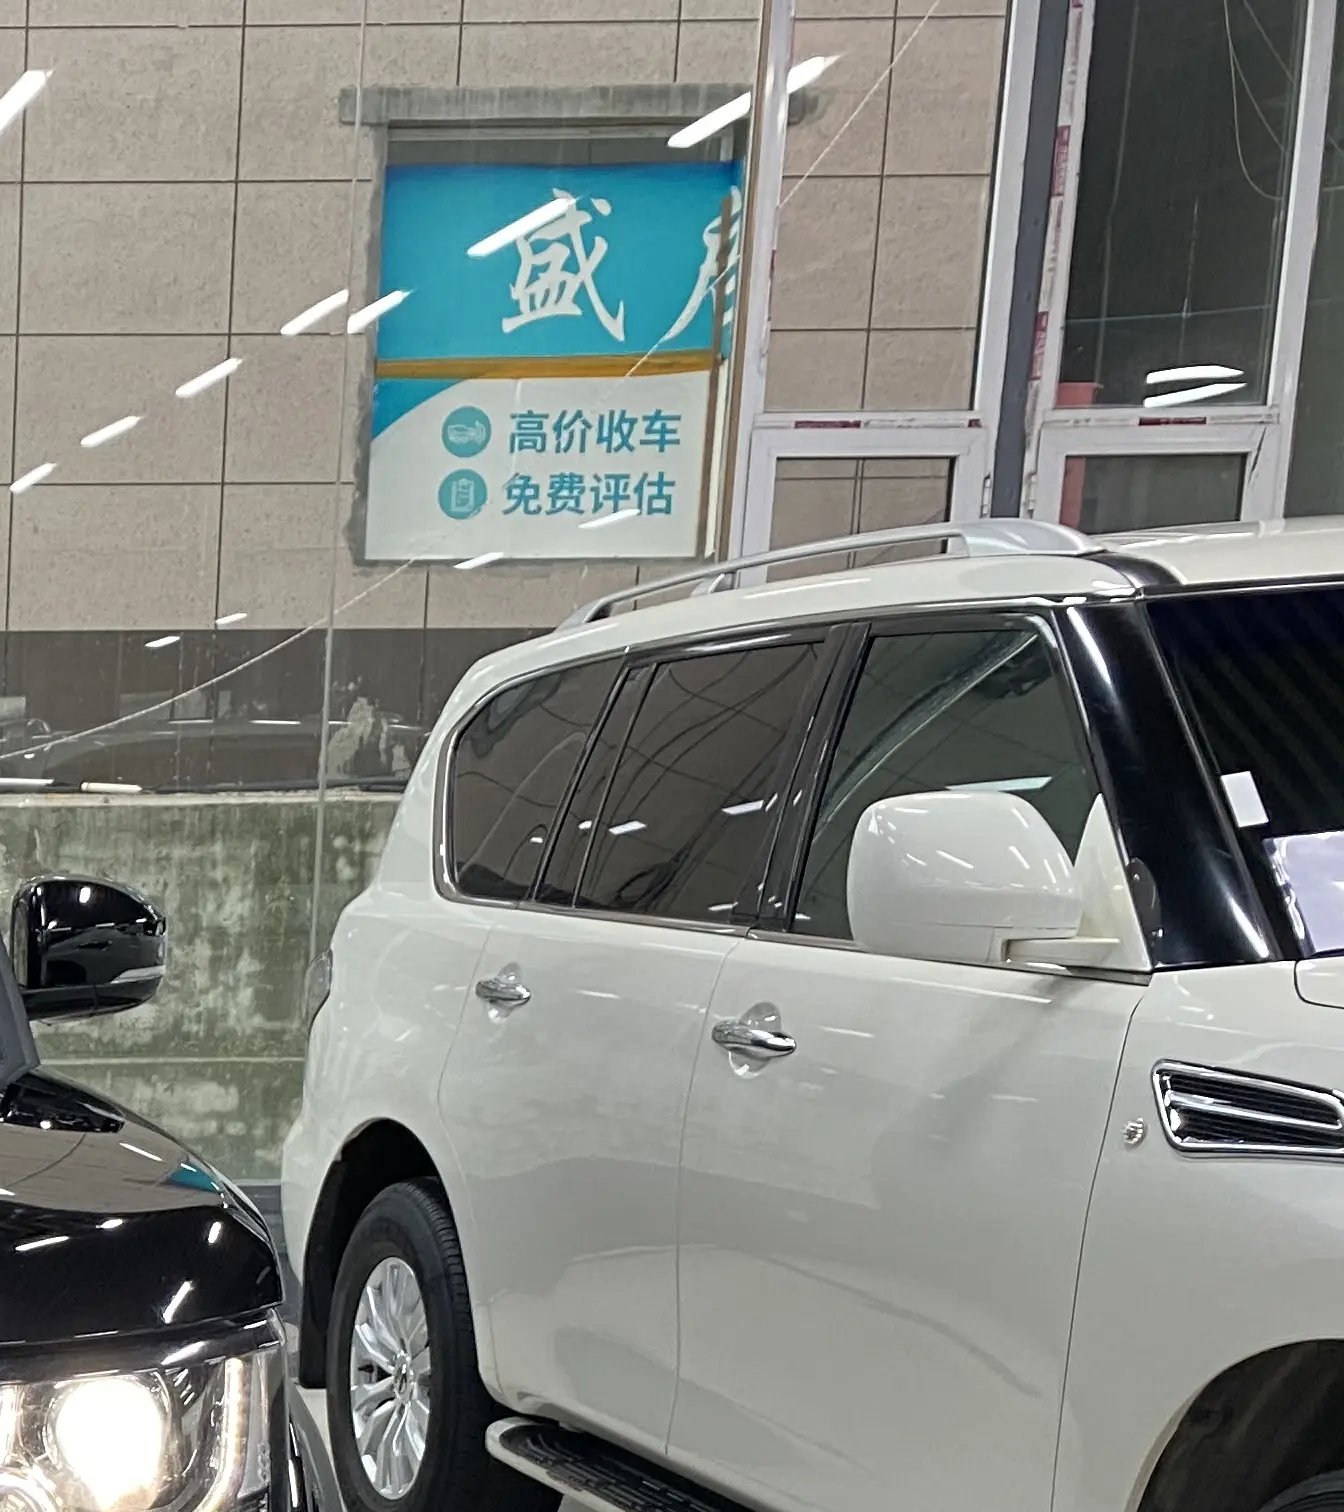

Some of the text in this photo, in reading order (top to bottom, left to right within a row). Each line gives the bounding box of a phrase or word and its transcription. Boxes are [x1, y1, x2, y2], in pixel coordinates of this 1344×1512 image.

[508, 408, 682, 455] 高价收车
[501, 472, 676, 517] 免费评估
